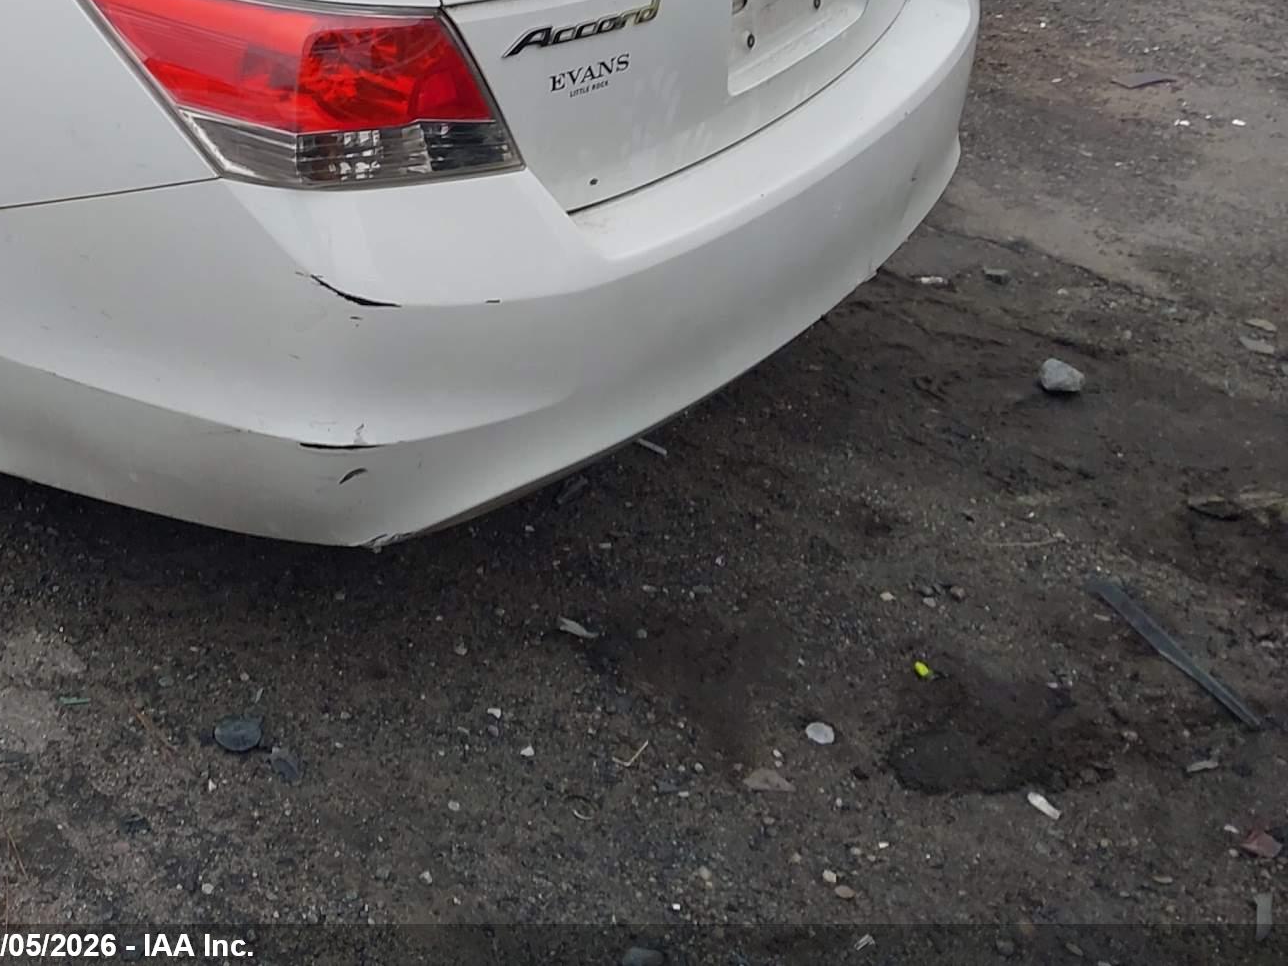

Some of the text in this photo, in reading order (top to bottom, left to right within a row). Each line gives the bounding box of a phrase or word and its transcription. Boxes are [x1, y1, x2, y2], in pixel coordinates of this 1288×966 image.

[549, 53, 630, 92] EVANS
[569, 80, 609, 98] LITTLE ROCK
